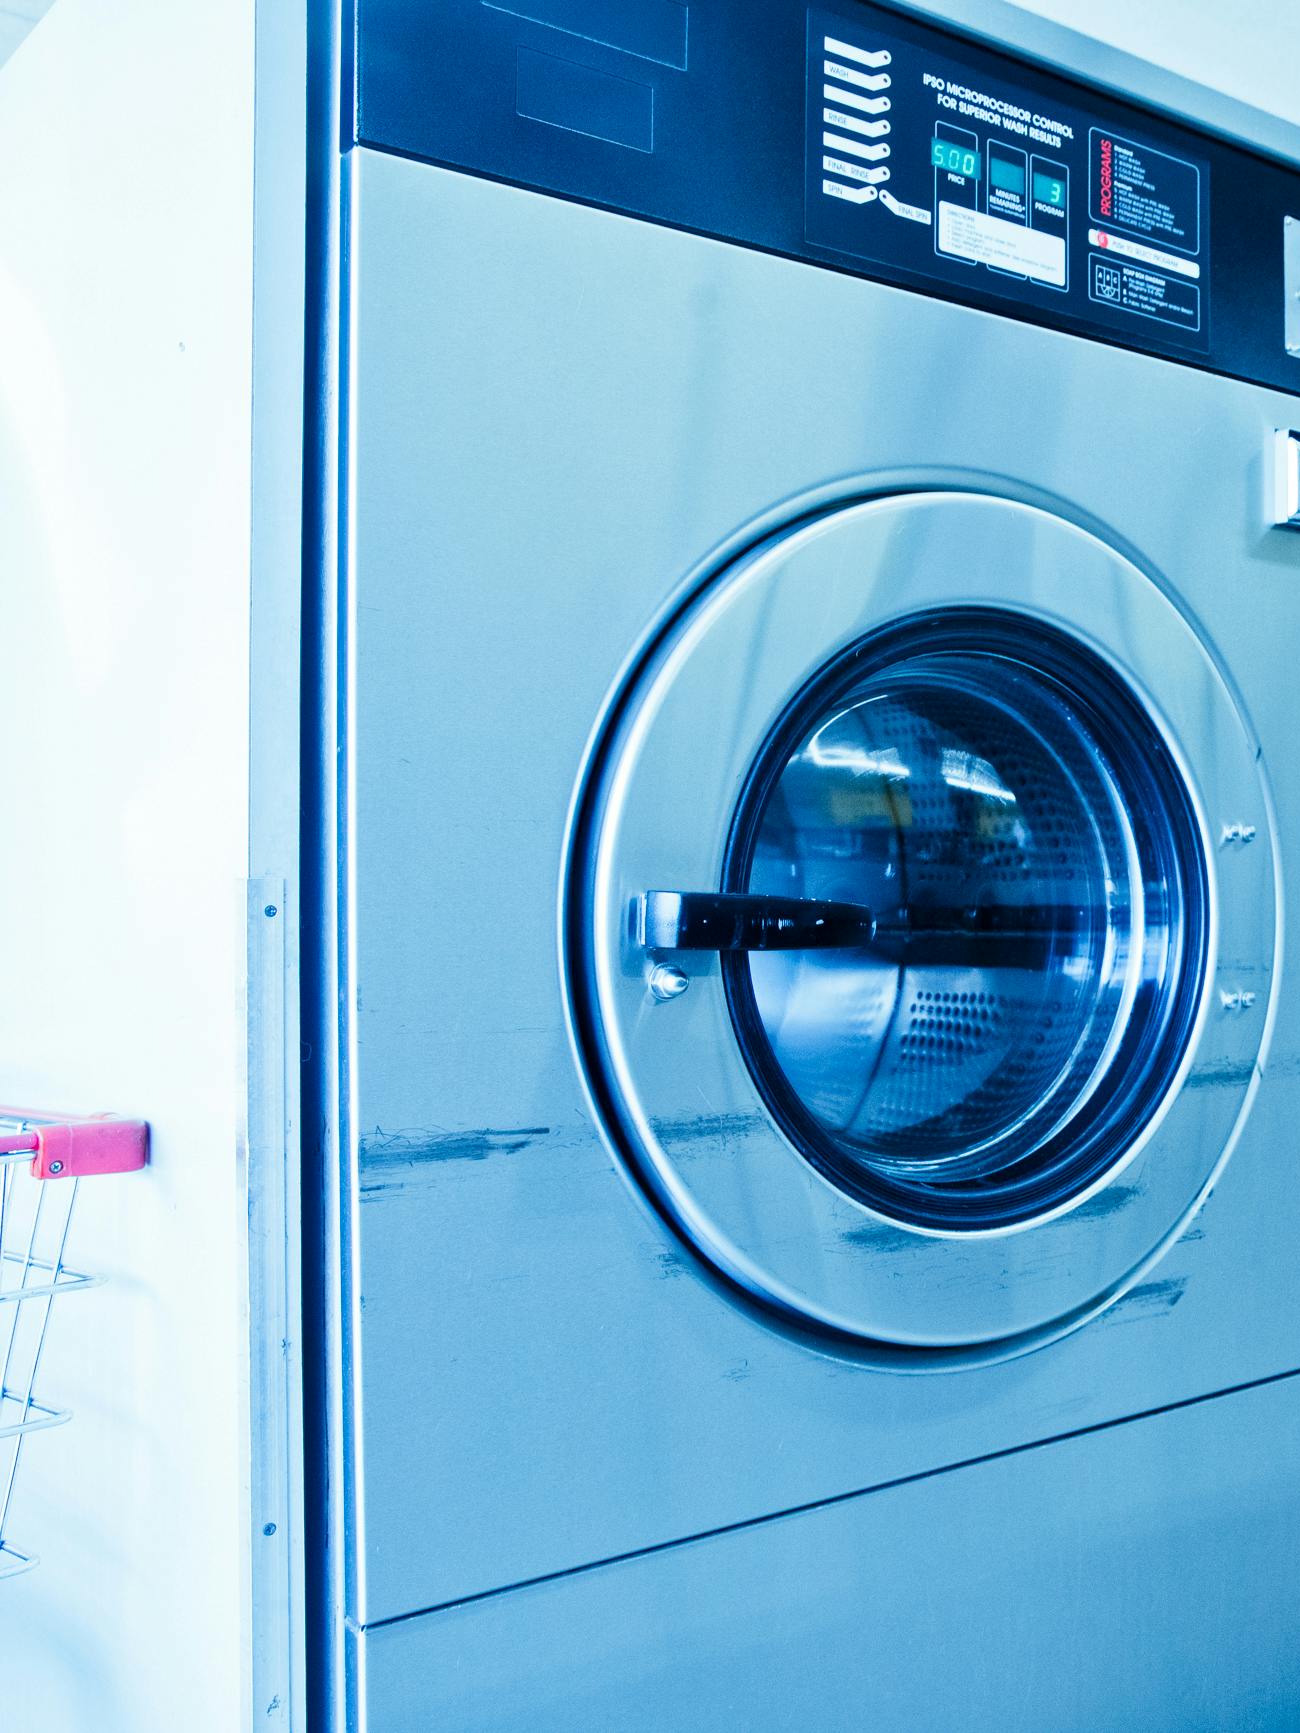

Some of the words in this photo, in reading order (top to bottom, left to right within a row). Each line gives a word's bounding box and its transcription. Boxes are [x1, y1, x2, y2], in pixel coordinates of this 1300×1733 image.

[829, 66, 848, 78] WASH
[923, 72, 945, 90] IPSO
[946, 81, 1032, 123] MICROPROCESSOR
[1032, 114, 1074, 139] CONTROL
[937, 93, 957, 110] FOR
[958, 101, 1001, 126] SUPERIOR
[1002, 116, 1028, 136] WASH
[1029, 126, 1062, 148] RESULTS
[828, 160, 846, 172] FINAL
[947, 172, 965, 186] PRICE
[1100, 139, 1112, 216] PROGRAMS
[828, 184, 842, 195] SPIN
[995, 188, 1020, 203] MINUTES
[1050, 183, 1061, 203] 3
[1034, 201, 1064, 218] PROGRAM
